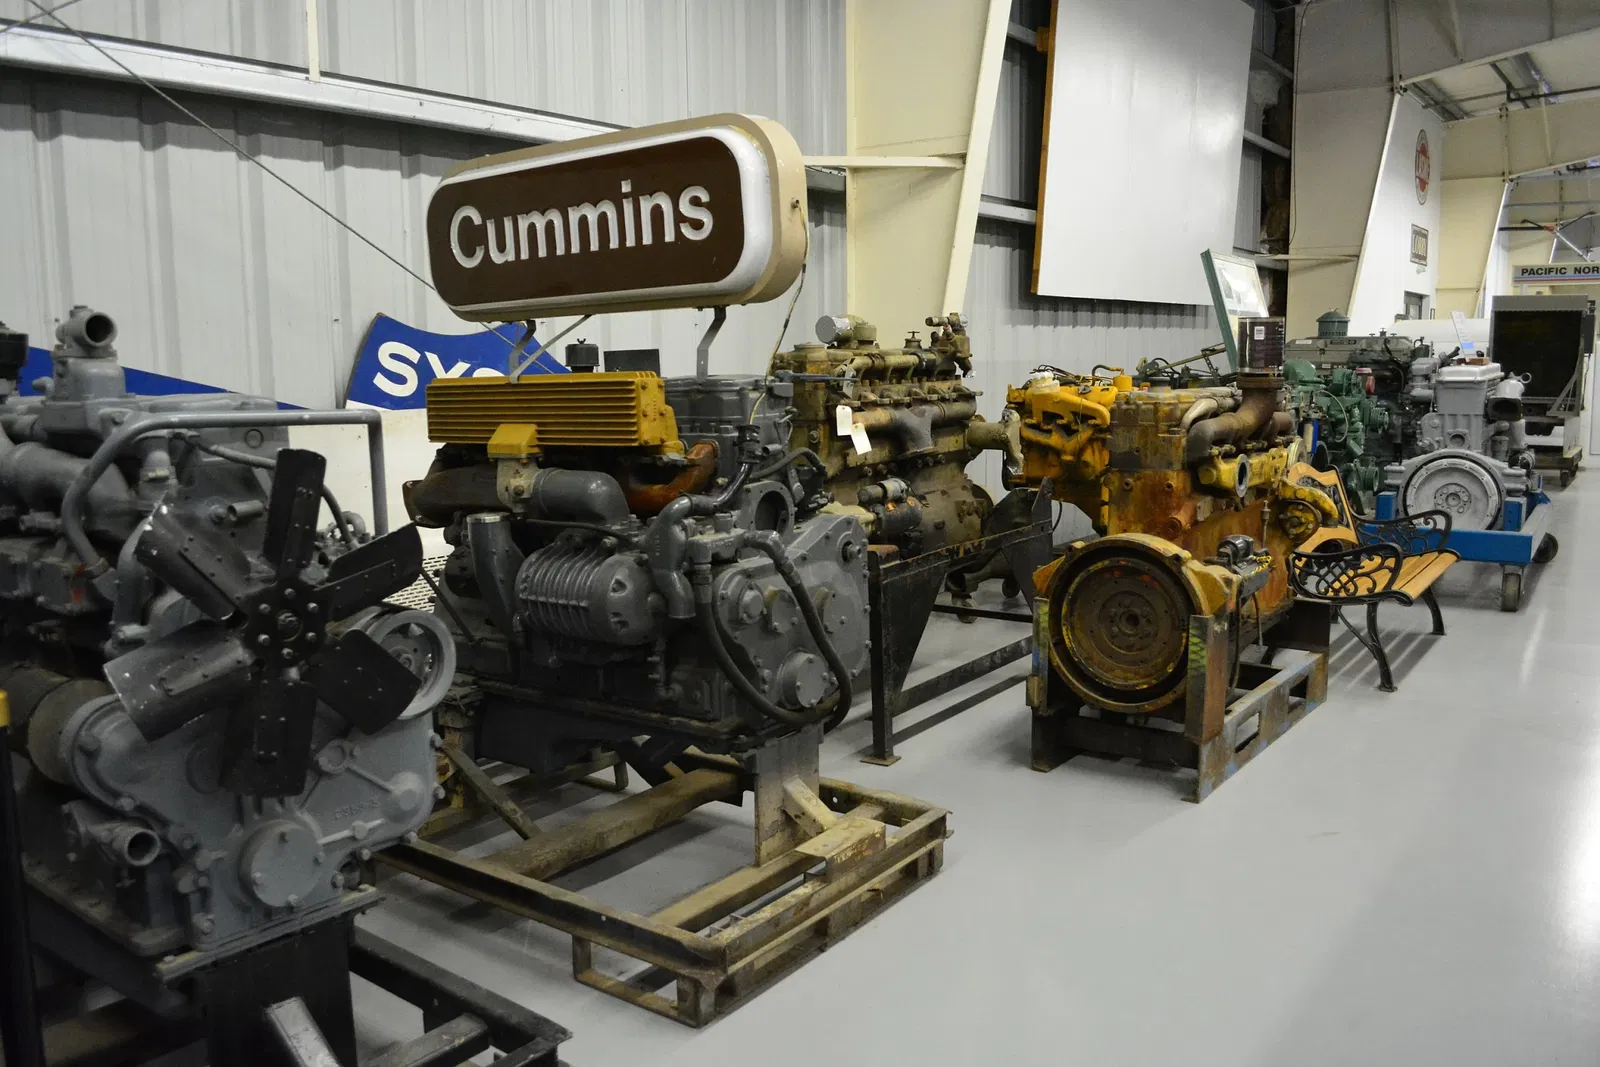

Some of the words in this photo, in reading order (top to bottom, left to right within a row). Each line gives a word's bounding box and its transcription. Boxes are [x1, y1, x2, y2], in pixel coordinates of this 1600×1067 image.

[450, 180, 714, 269] Cummins
[1521, 267, 1567, 276] PACIFIC
[1574, 266, 1600, 275] NOR
